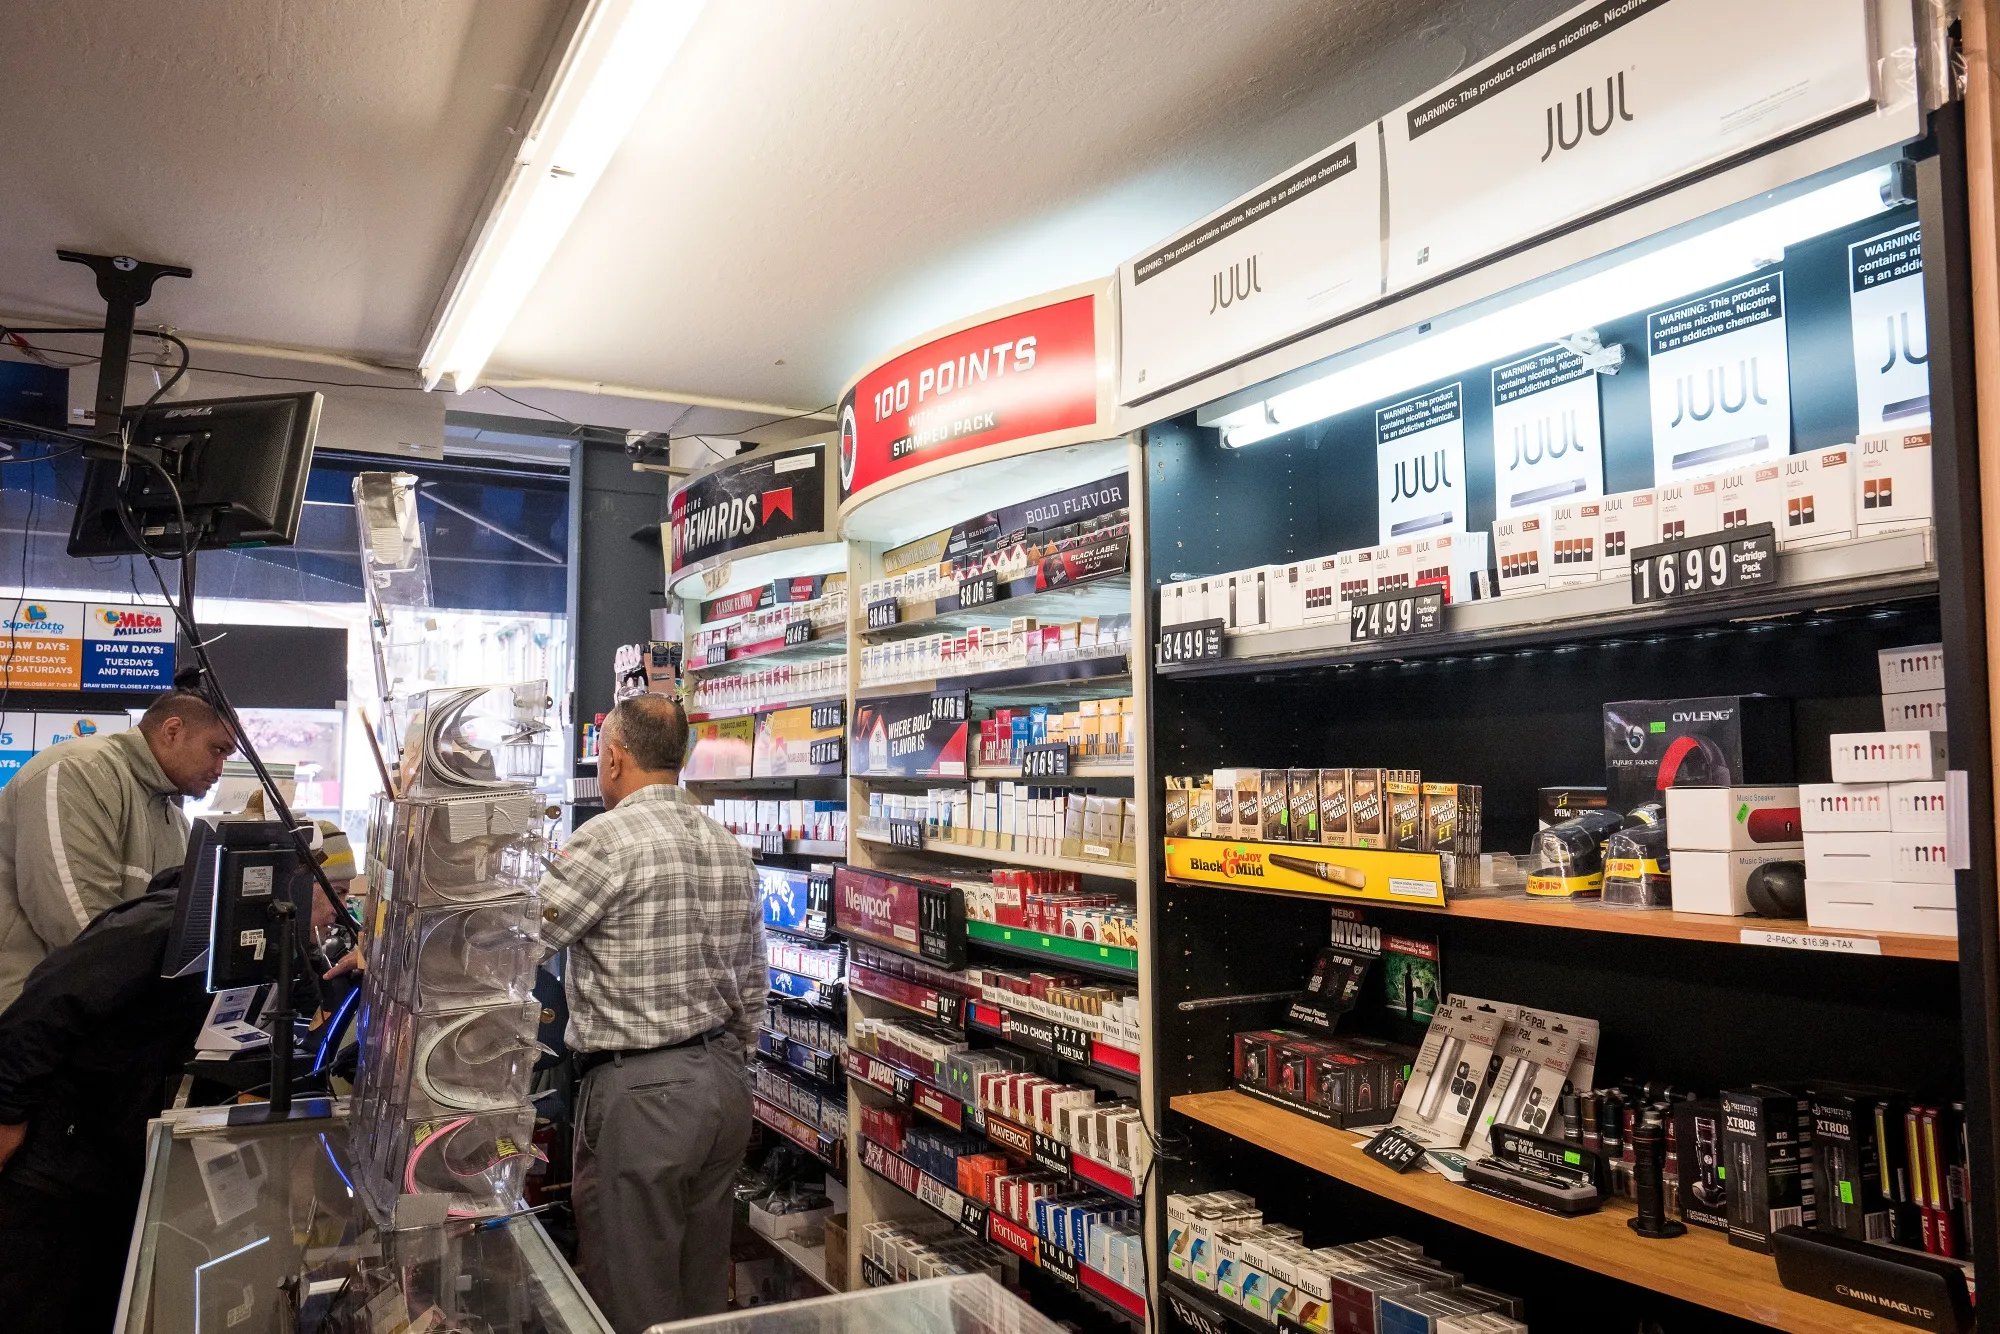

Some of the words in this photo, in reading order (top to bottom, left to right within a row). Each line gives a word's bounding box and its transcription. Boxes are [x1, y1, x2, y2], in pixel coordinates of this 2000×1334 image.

[1414, 98, 1458, 128] WARNING:
[1459, 88, 1478, 103] This
[1480, 66, 1514, 94] product
[1516, 44, 1557, 72] contains
[1558, 20, 1602, 50] nicotine.
[1541, 71, 1634, 162] JUUL
[1138, 257, 1164, 276] WARNING:
[1164, 251, 1174, 262] This
[1176, 240, 1196, 258] product
[1196, 227, 1219, 245] contains
[1220, 214, 1244, 232] nicotine.
[1245, 200, 1270, 218] Nicotine
[1271, 196, 1277, 204] is
[1278, 191, 1286, 200] an
[1288, 174, 1316, 195] addictive
[1318, 155, 1351, 179] chemical.
[1858, 252, 1906, 273] contains
[1210, 254, 1261, 315] JUUL
[1864, 275, 1874, 285] is
[1877, 270, 1891, 281] an
[1659, 304, 1707, 326] WARNING:
[1709, 297, 1729, 309] This
[1732, 282, 1770, 305] product
[1654, 321, 1692, 339] contains
[1694, 309, 1733, 326] nicotine.
[1736, 295, 1776, 313] Nicotine
[1659, 340, 1667, 349] is
[1669, 337, 1680, 347] an
[1682, 324, 1724, 342] addictive
[1726, 308, 1772, 329] chemical.
[1501, 362, 1538, 380] WARNING:
[1539, 355, 1554, 366] This
[874, 378, 909, 423] 100
[919, 335, 1036, 402] POINTS
[1497, 376, 1526, 392] contains
[1528, 366, 1557, 381] nicotine.
[1500, 393, 1507, 401] is
[1508, 390, 1517, 399] an
[1518, 380, 1550, 396] addictive
[1551, 369, 1586, 384] chemical.
[1671, 356, 1767, 428] JUUL
[1384, 405, 1414, 420] WARNING:
[1415, 400, 1428, 409] This
[1429, 390, 1453, 406] product
[1380, 419, 1405, 431] contains
[1406, 411, 1431, 423] nicotine.
[1432, 400, 1457, 414] Nicotine
[1399, 422, 1424, 435] addictive
[1426, 411, 1454, 426] chemical.
[893, 423, 948, 457] STAMPED
[954, 412, 996, 435] PACK
[1510, 409, 1584, 471] JUUL
[1863, 440, 1888, 454] JUUL
[1786, 460, 1809, 475] JUUL
[1823, 455, 1841, 463] 5.0%
[1391, 449, 1452, 503] JUUL
[1722, 475, 1744, 490] JUUL
[1025, 504, 1059, 524] BOLD
[1064, 486, 1122, 515] FLAVOR
[683, 494, 757, 554] REWARDS
[1071, 550, 1094, 562] BLACK
[1096, 544, 1119, 555] LABEL
[1744, 540, 1756, 549] Per
[1733, 550, 1766, 563] Cartridge
[1634, 545, 1726, 599] $16.99
[1742, 564, 1761, 572] Pack
[960, 580, 984, 607] $8.06
[2, 620, 64, 631] SuperLotto
[116, 612, 162, 628] MEGA
[1353, 599, 1411, 637] $24.99
[113, 626, 162, 636] MILLIONS
[36, 642, 69, 650] DAYS:
[96, 644, 128, 652] DRAW
[132, 646, 164, 654] DAYS:
[1163, 629, 1203, 660] $34.99
[1, 655, 66, 663] WEDNESDAYS
[105, 658, 153, 666] TUESDAYS
[16, 666, 73, 674] SATURDAYS
[121, 668, 159, 676] FRIDAYS
[1672, 710, 1731, 722] OVLENG
[888, 717, 910, 740] WHERE
[1, 733, 13, 745] 5
[891, 738, 916, 757] FLAVOR
[917, 734, 924, 750] IS
[1025, 750, 1053, 774] $7.69
[1290, 790, 1314, 808] Black
[1393, 799, 1416, 814] Black
[1431, 800, 1454, 816] Black
[1298, 800, 1316, 818] Mild
[1400, 809, 1417, 823] Mild
[1438, 810, 1456, 824] Mild
[1402, 822, 1413, 837] FT
[1439, 824, 1451, 840] FT
[1236, 863, 1264, 877] Mild
[845, 886, 891, 919] Newport
[1332, 907, 1354, 920] NEBO
[1331, 920, 1381, 950] MYCRO
[1766, 934, 1798, 945] 2-PACK
[1802, 937, 1829, 948] $16.99
[1831, 939, 1853, 949] +TAX
[776, 973, 792, 991] CAMEL
[1011, 1020, 1028, 1034] BOLD
[1030, 1026, 1052, 1043] CHOICE
[1431, 1023, 1447, 1032] LIGHT
[1470, 1033, 1490, 1044] CHARGE
[1057, 1044, 1072, 1057] PLUS
[1072, 1048, 1084, 1061] TAX
[1510, 1045, 1525, 1054] LIGHT
[1545, 1058, 1564, 1069] CHARGE
[1727, 1116, 1756, 1131] XT808
[1817, 1120, 1849, 1134] XT808
[991, 1122, 1028, 1150] MAVERICK
[1519, 1139, 1534, 1147] MINI
[1036, 1153, 1044, 1164] TAX
[1045, 1158, 1067, 1174] INCLUDED
[1518, 1146, 1563, 1164] MAGLITE
[886, 1152, 898, 1178] PALL
[900, 1161, 913, 1192] MALL
[993, 1218, 1027, 1251] Fortuna
[1244, 1252, 1263, 1268] MERIT
[1042, 1258, 1051, 1269] TAX
[1051, 1263, 1075, 1284] INCLUDED
[1271, 1266, 1291, 1282] MERIT
[1301, 1280, 1323, 1297] MERIT
[1850, 1289, 1877, 1304] MINI
[1879, 1297, 1931, 1319] MAGLITE
